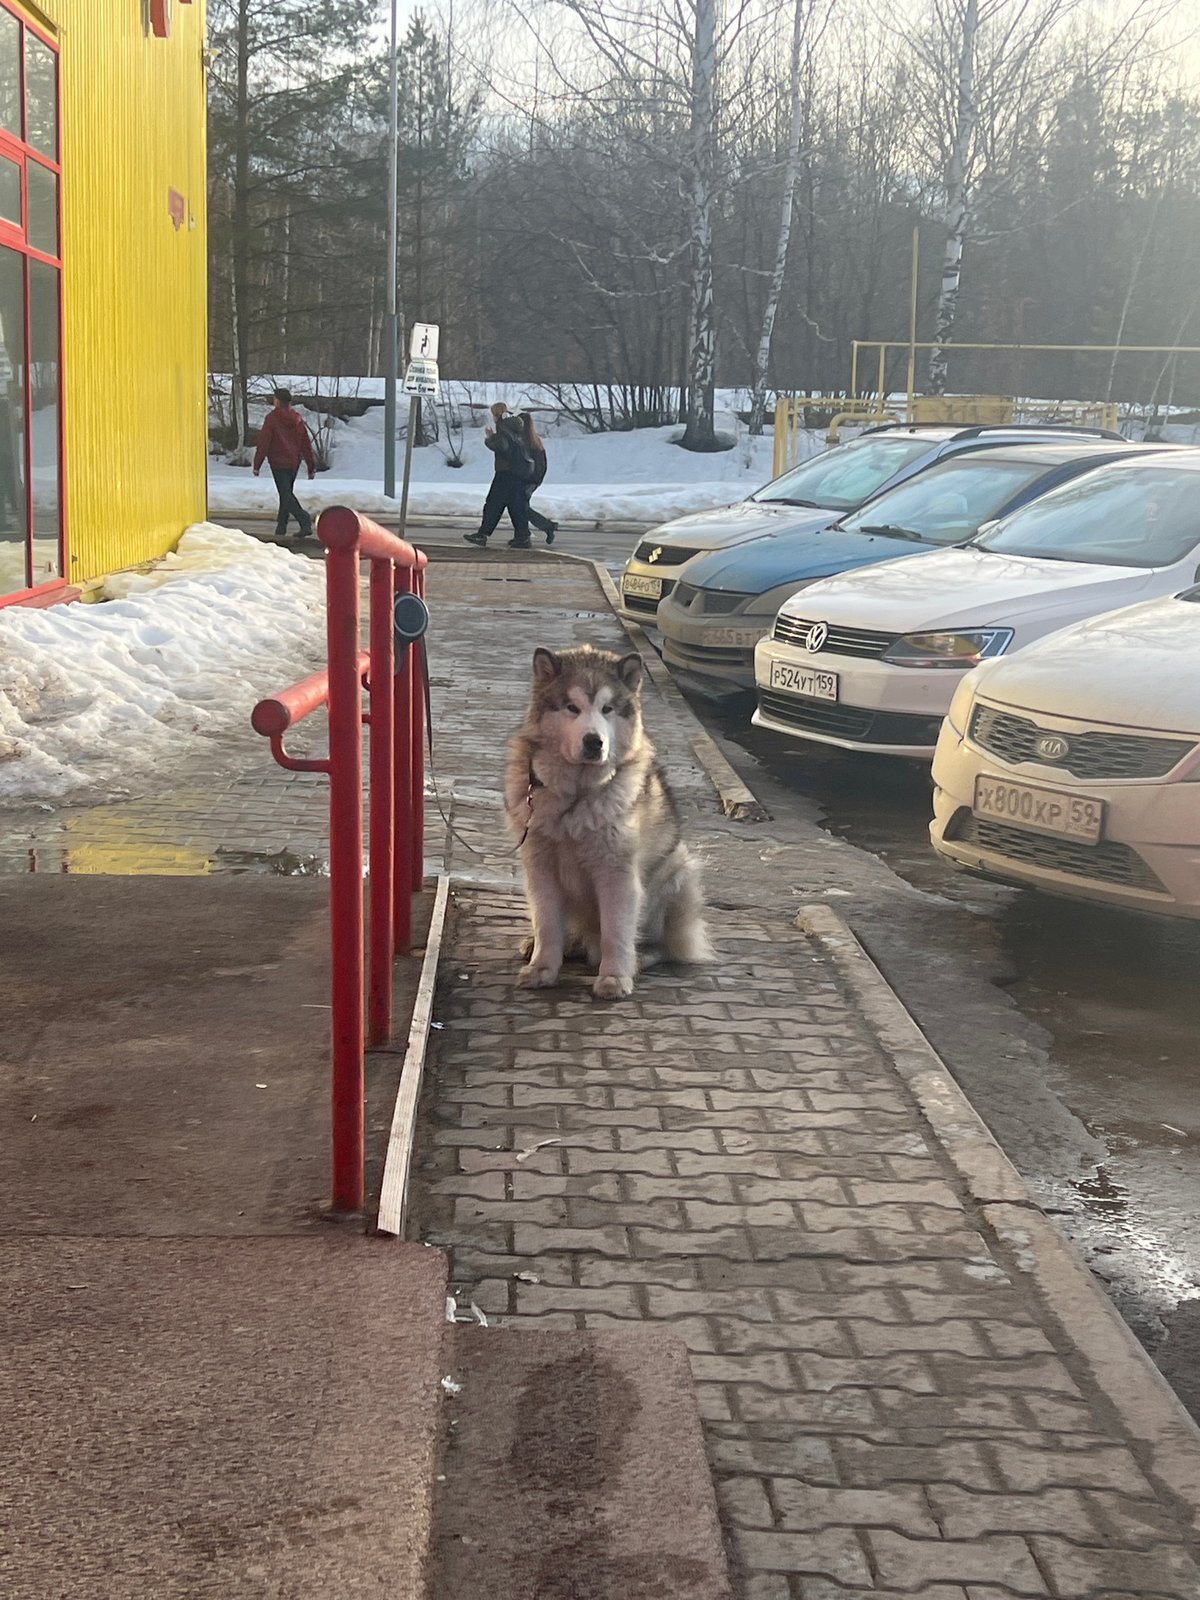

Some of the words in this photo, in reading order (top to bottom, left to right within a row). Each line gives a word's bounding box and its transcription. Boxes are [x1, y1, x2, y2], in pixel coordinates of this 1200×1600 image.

[774, 667, 814, 693] Р524УТ
[816, 674, 834, 692] 159
[1039, 739, 1062, 754] KIA
[982, 785, 1062, 825] Х800ХР
[1071, 800, 1096, 826] 59
